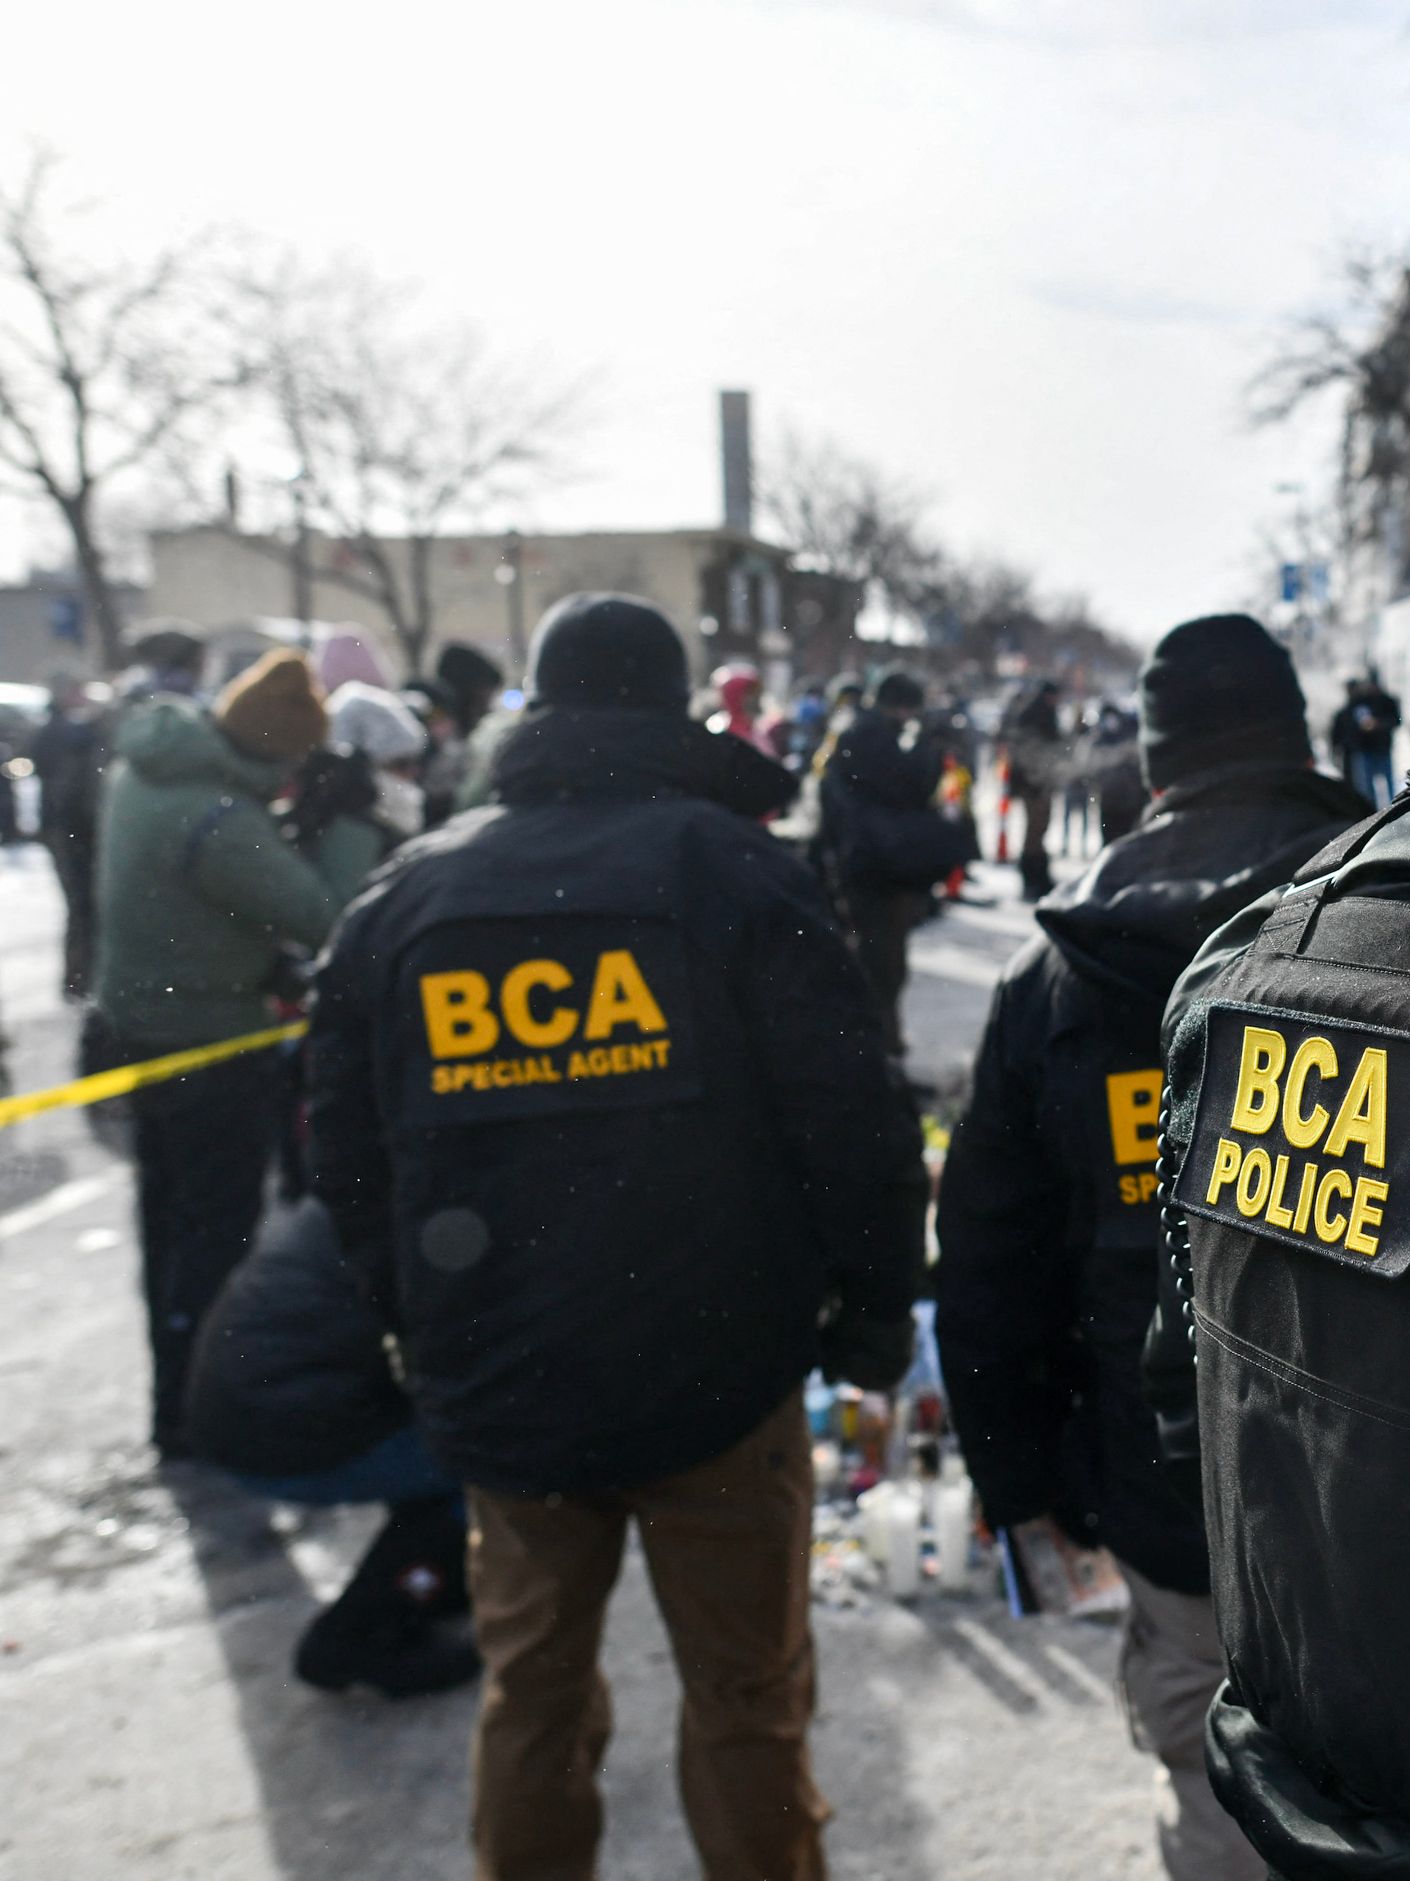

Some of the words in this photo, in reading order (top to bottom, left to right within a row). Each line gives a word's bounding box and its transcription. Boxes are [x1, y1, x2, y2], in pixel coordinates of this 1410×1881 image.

[420, 949, 668, 1060] BCA
[432, 1056, 562, 1094] SPECIAL
[568, 1039, 671, 1079] AGENT
[1230, 1025, 1389, 1169] BCA
[1205, 1137, 1390, 1256] POLICE
